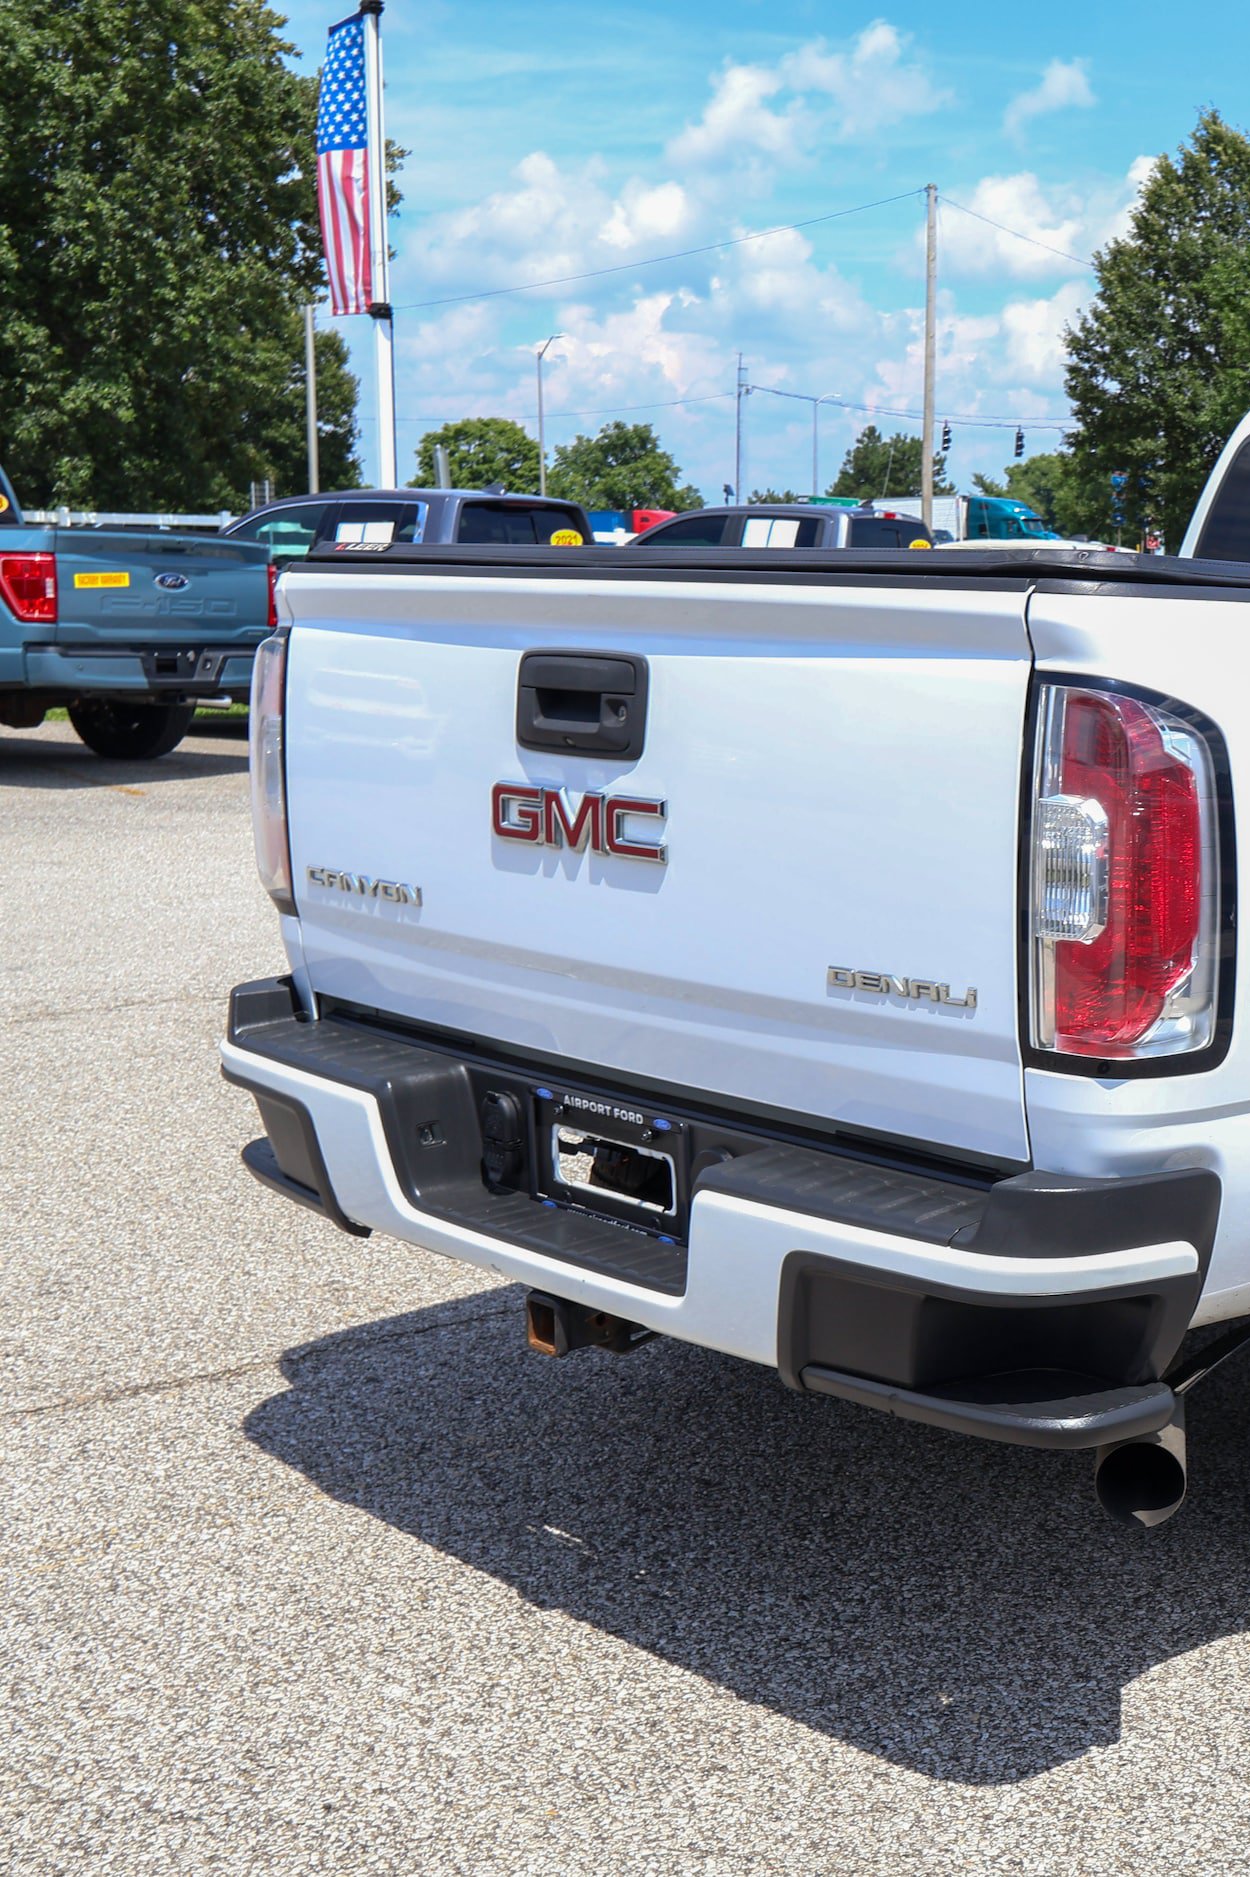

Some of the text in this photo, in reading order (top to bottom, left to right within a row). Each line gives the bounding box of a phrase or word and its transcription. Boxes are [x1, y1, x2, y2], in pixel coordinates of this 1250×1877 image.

[101, 594, 238, 617] F-150
[491, 780, 669, 865] GMC
[306, 864, 423, 907] CANYON
[826, 965, 978, 1008] DENALI
[563, 1094, 611, 1117] AIRPORT
[613, 1107, 644, 1125] FORD
